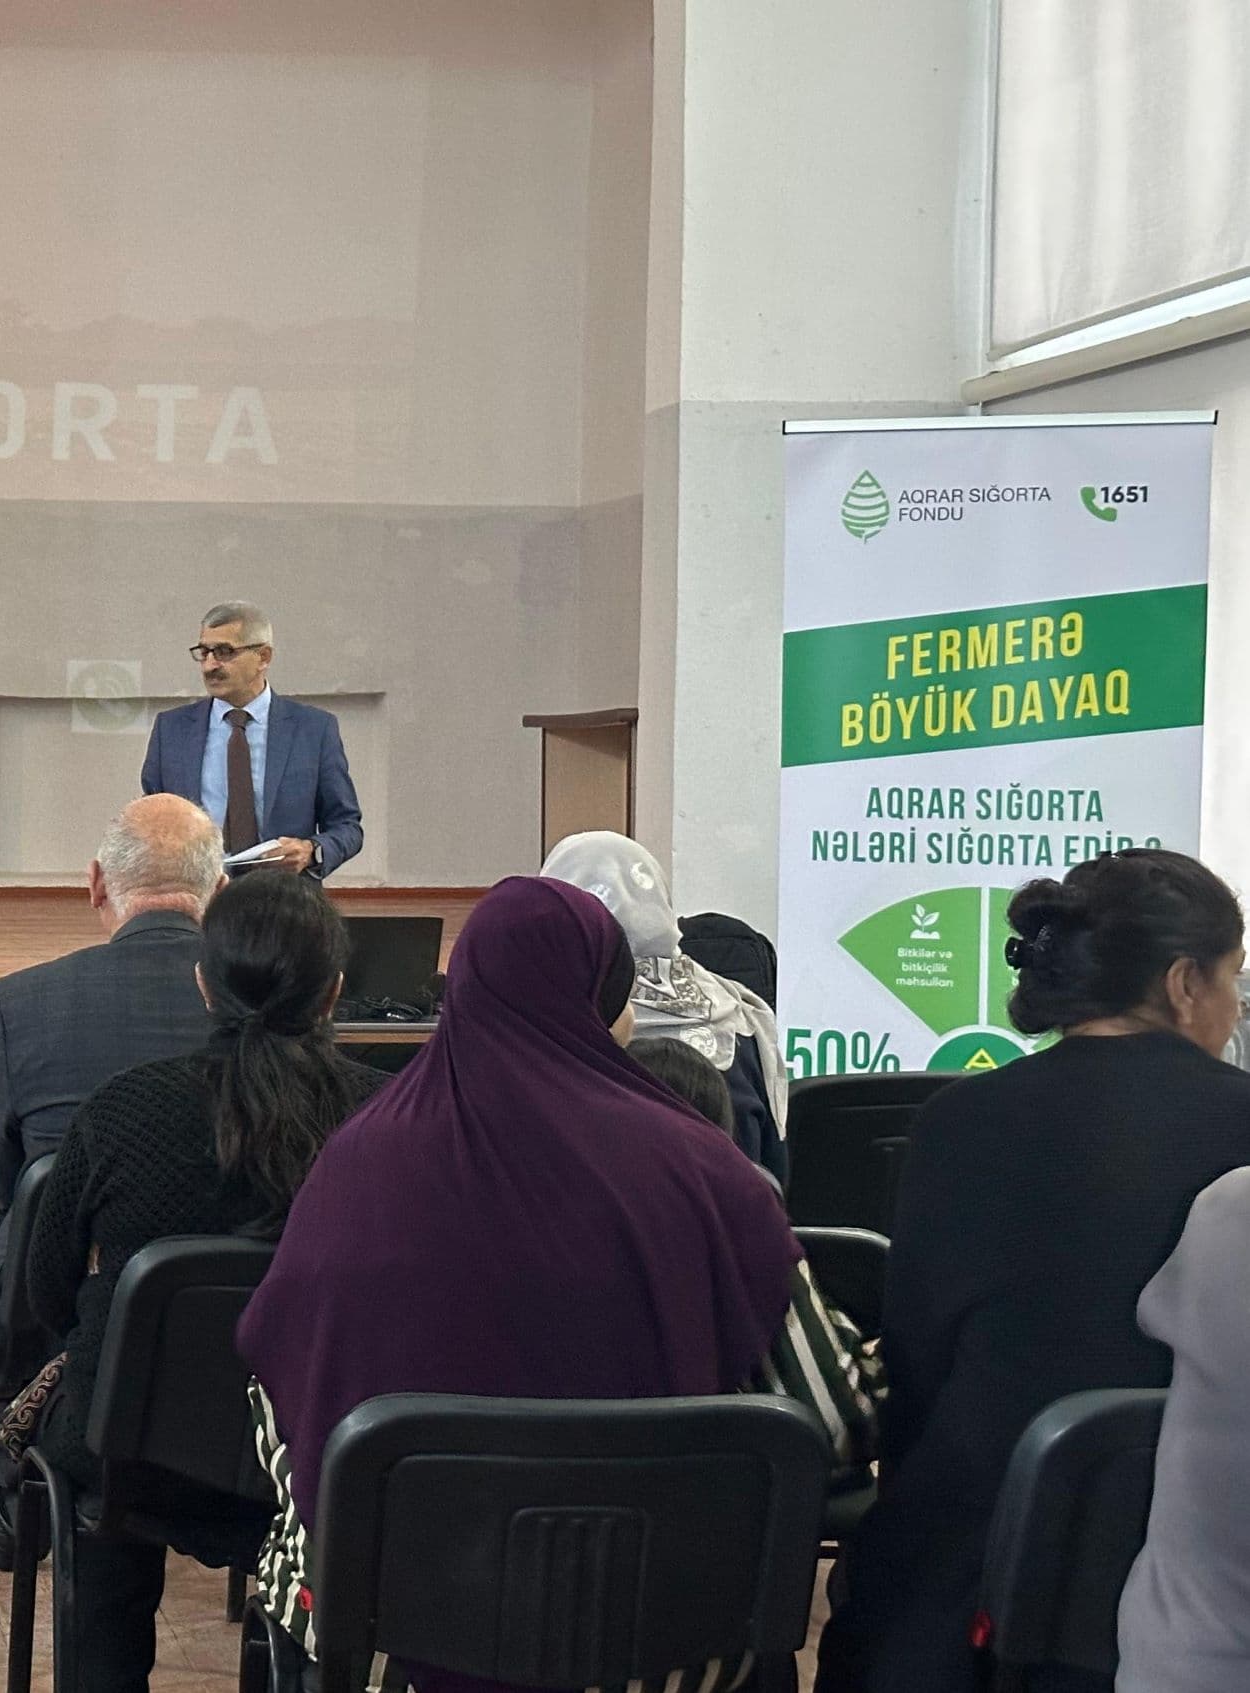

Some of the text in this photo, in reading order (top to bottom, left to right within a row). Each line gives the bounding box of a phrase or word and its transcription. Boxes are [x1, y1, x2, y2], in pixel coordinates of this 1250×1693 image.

[898, 484, 1051, 504] AQRAR SIĞORTA
[1100, 486, 1149, 503] 1651
[898, 507, 964, 522] FONDU
[887, 612, 1084, 680] FERMERƏ
[840, 669, 1131, 748] BÖYÜK DAYAQ
[865, 782, 1104, 822] AQRAR SIĞORTA
[811, 826, 917, 864] NƏLƏRİ
[926, 826, 1053, 867] SIĞORTA
[786, 1028, 900, 1080] 50%
